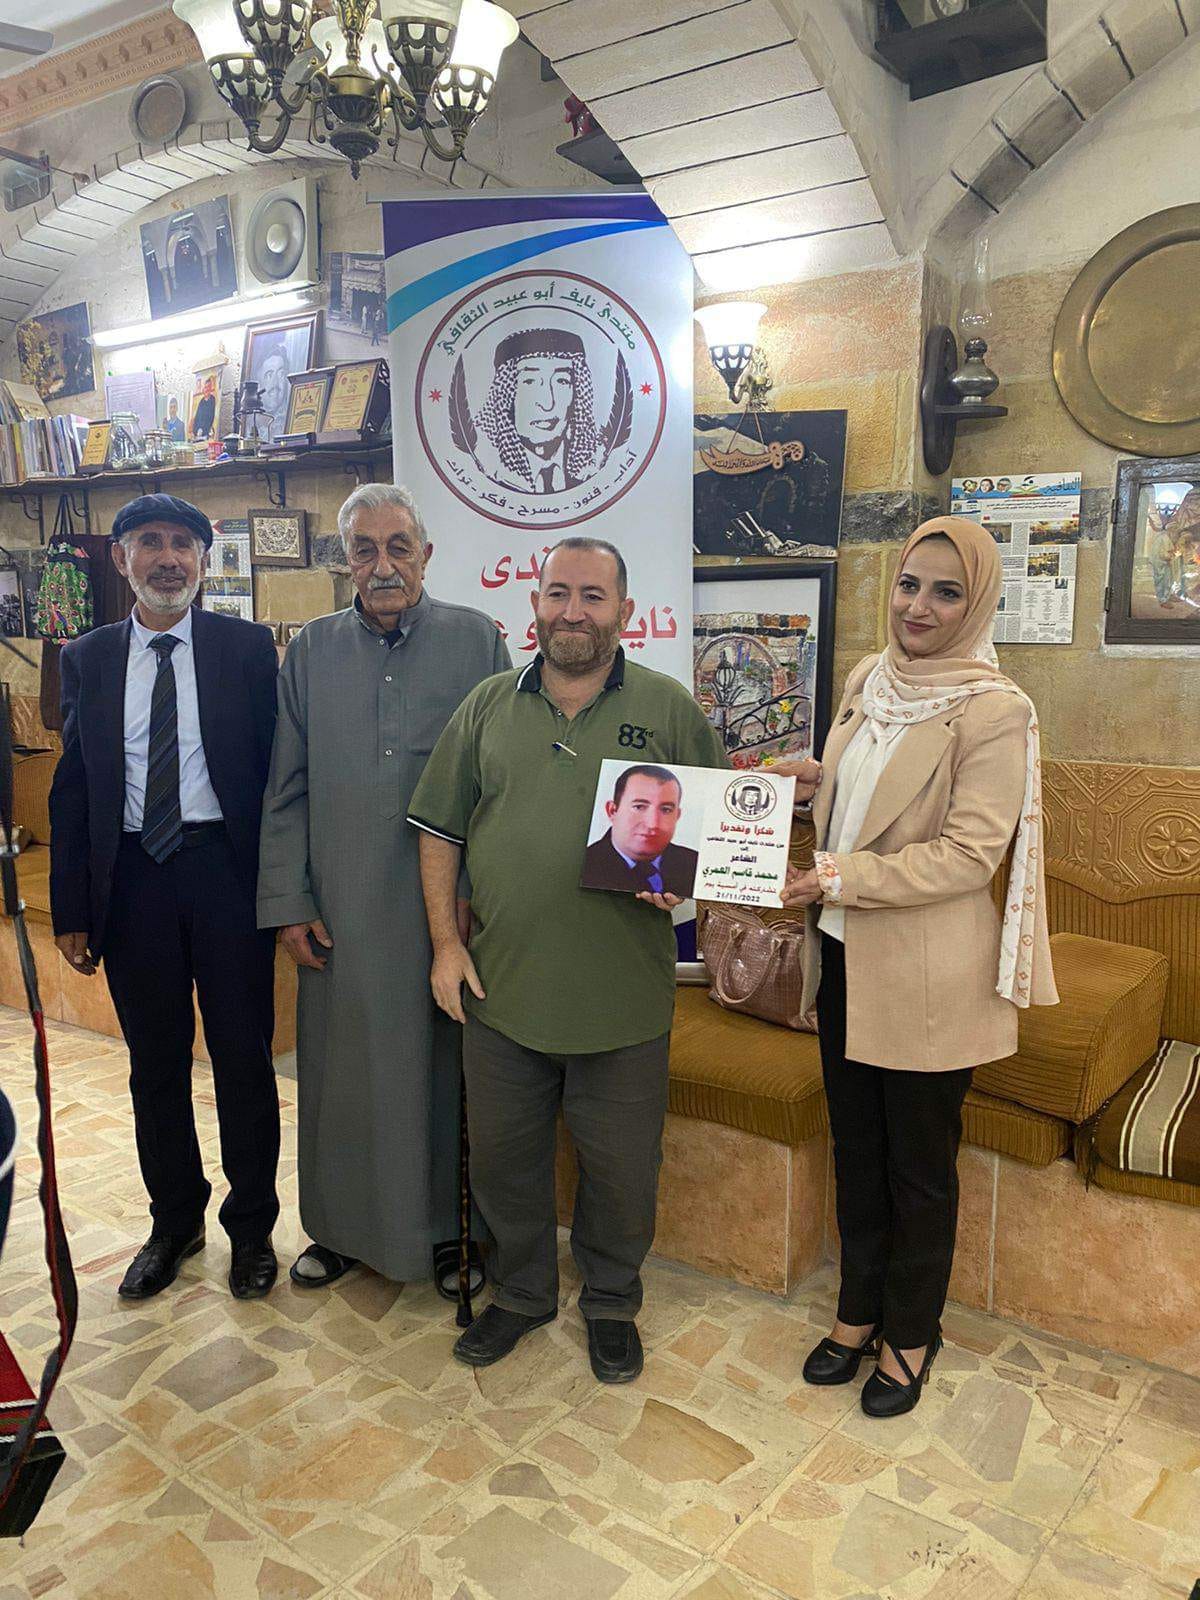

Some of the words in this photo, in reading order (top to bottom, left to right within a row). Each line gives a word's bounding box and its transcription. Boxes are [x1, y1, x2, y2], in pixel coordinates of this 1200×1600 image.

[493, 290, 528, 309] عبيد
[533, 281, 555, 300] أبو
[560, 288, 596, 309] نايف
[437, 302, 489, 356] الثقافي
[446, 459, 473, 485] تراث
[479, 493, 507, 508] فكر
[573, 486, 602, 509] فنون
[517, 505, 560, 516] مسرح
[619, 606, 677, 649] ناي
[730, 854, 757, 863] الشاعر
[732, 867, 753, 880] قاسم
[754, 871, 778, 880] محمد
[716, 891, 761, 903] 21/11/2022
